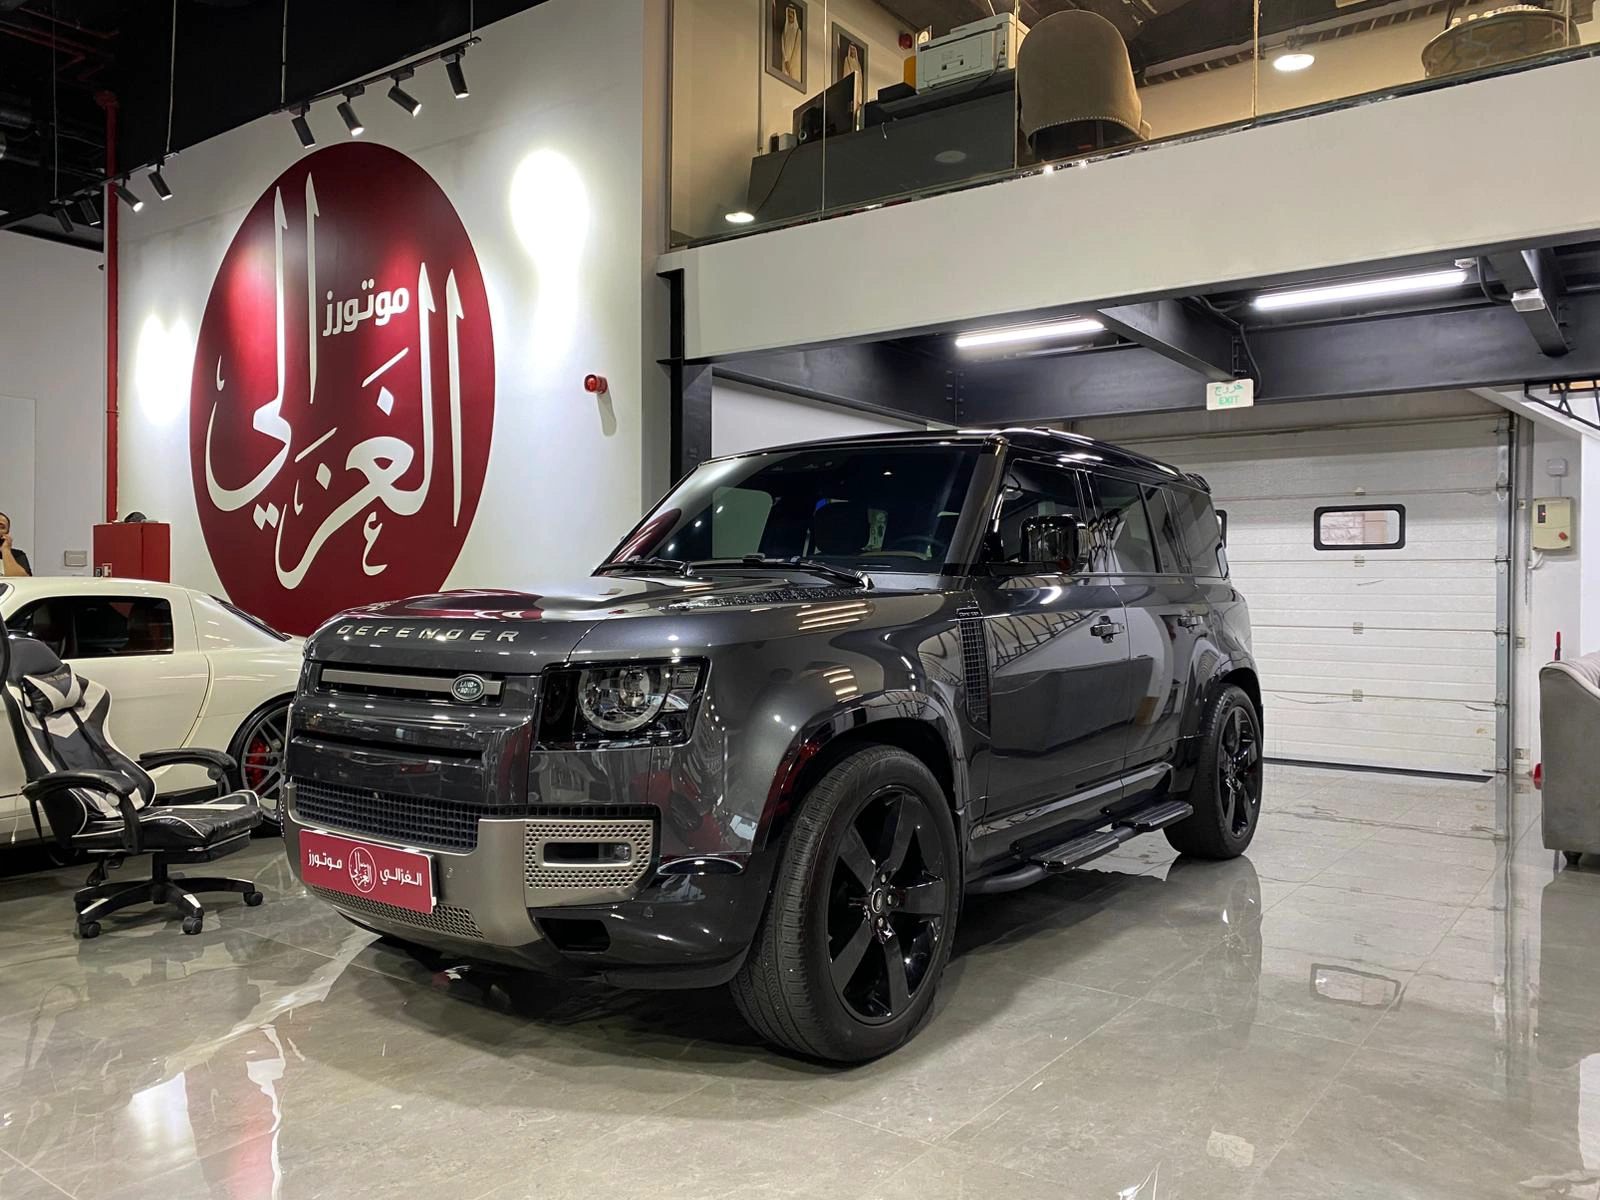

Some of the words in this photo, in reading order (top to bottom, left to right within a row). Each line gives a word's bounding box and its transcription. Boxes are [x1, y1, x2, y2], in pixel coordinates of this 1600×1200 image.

[322, 278, 410, 337] موتورز
[1218, 395, 1240, 405] EXIT
[336, 624, 520, 643] DEFENDER
[308, 849, 343, 871] موتورز
[379, 867, 423, 887] الغزالي
